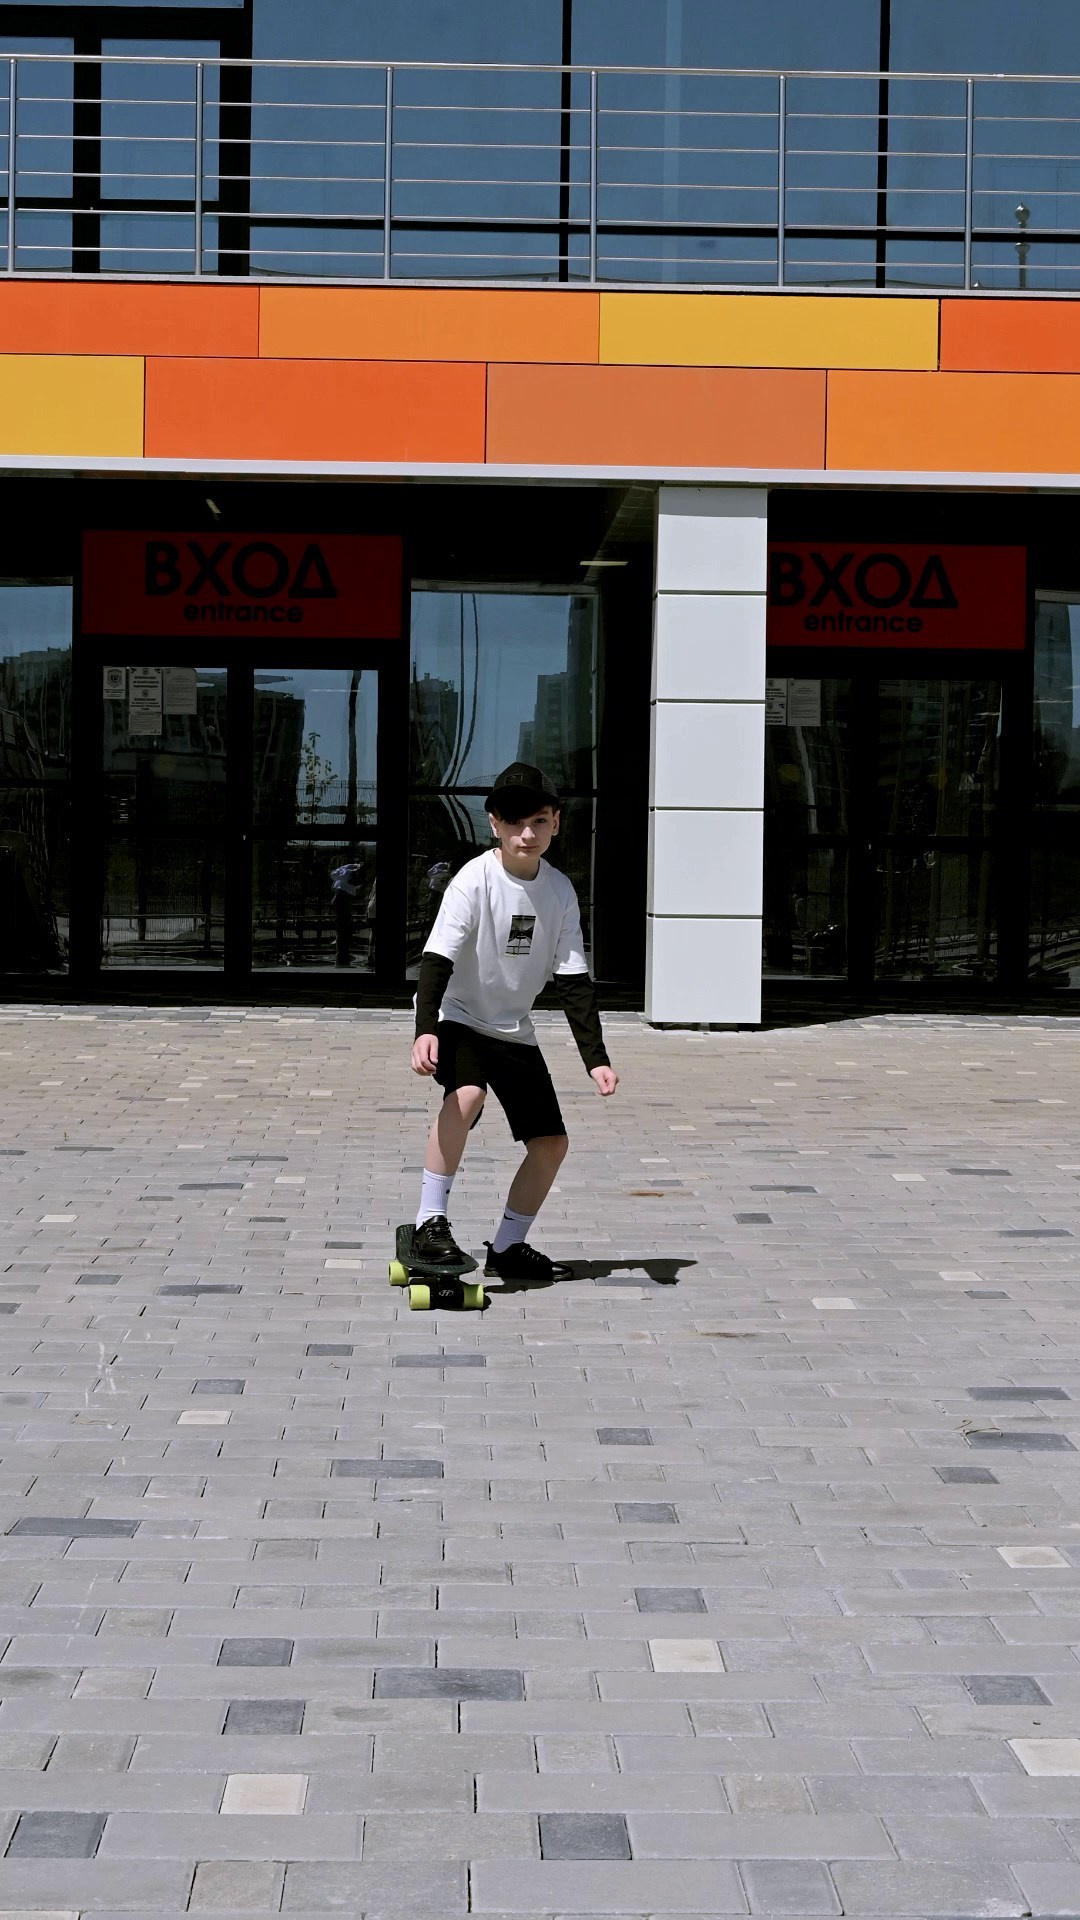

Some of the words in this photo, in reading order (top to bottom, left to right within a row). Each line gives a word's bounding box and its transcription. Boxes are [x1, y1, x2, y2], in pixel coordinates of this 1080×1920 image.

[146, 542, 337, 598] ВХОД
[771, 552, 958, 609] ВХОД
[184, 602, 304, 623] entrance
[804, 611, 925, 633] entrance
